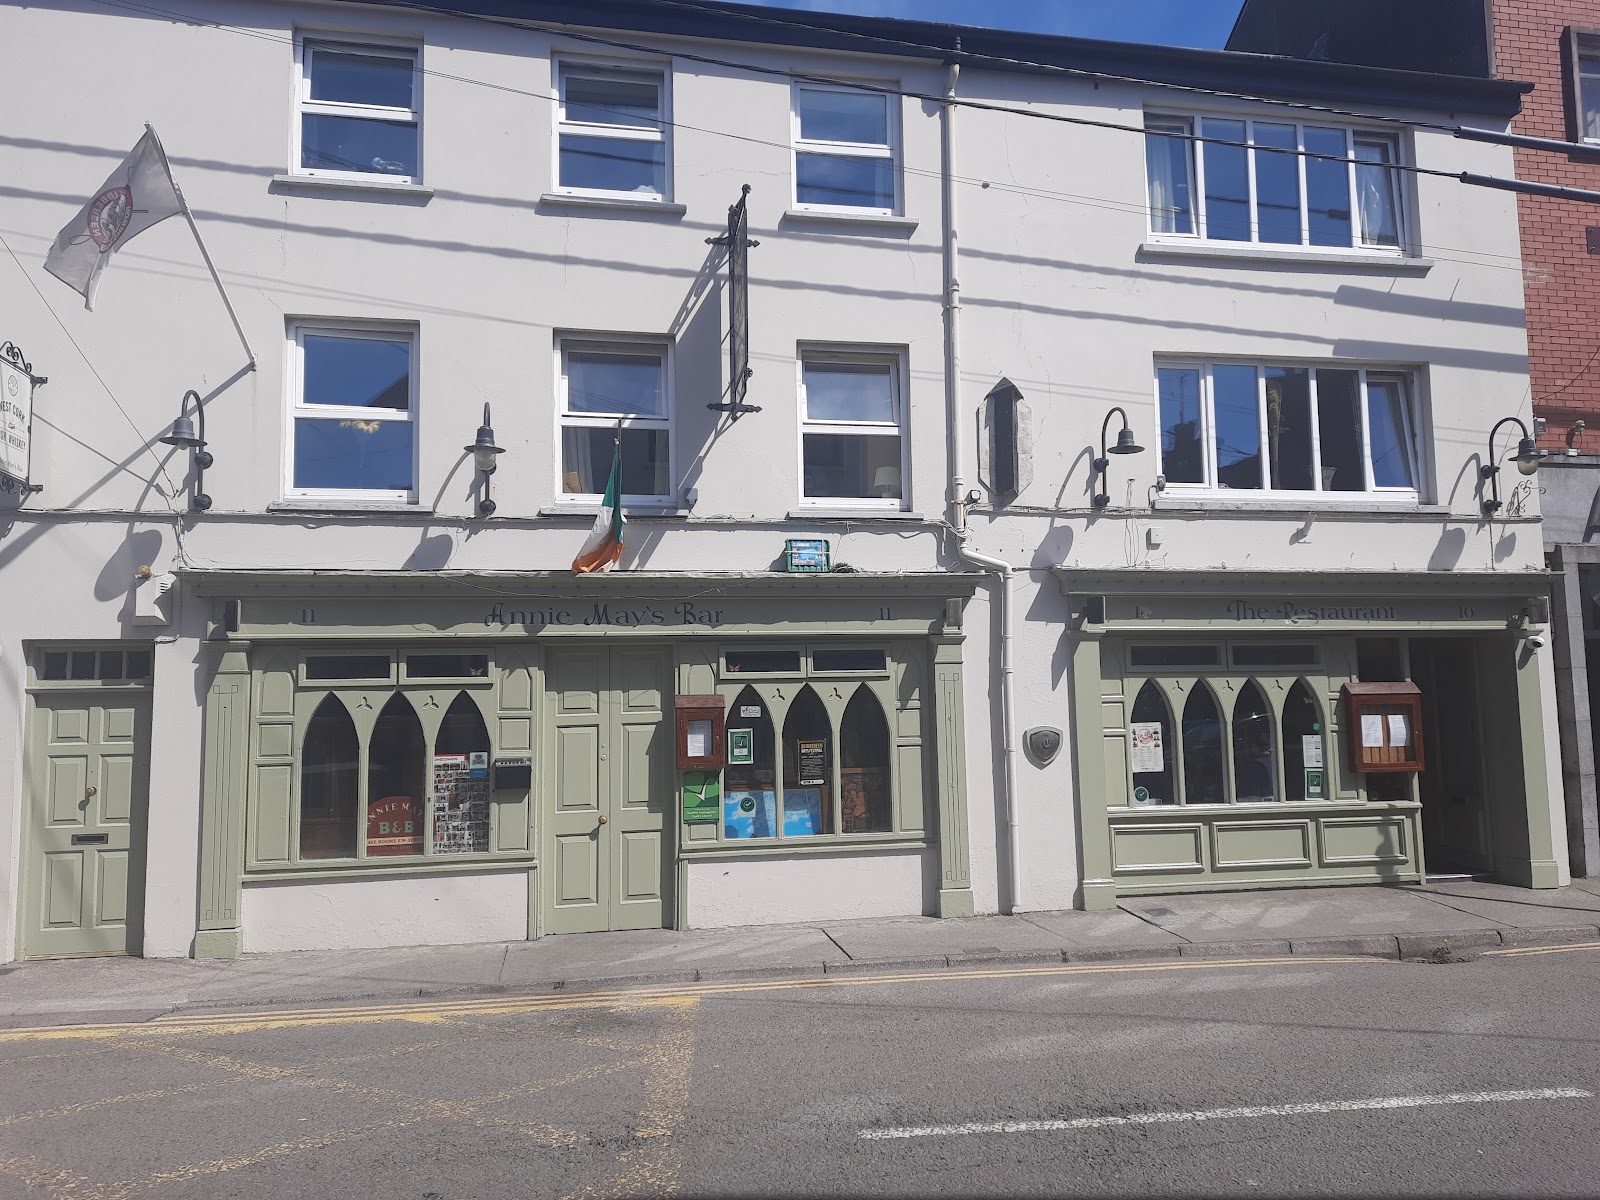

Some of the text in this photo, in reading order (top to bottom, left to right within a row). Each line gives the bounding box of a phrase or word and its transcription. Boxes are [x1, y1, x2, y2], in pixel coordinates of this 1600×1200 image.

[12, 404, 25, 421] CORK
[302, 608, 315, 623] 11
[484, 601, 724, 628] Annie May's Bar
[880, 607, 891, 621] 11
[1226, 599, 1395, 623] The Restaurant
[1457, 606, 1475, 619] 10
[379, 820, 414, 835] B&B
